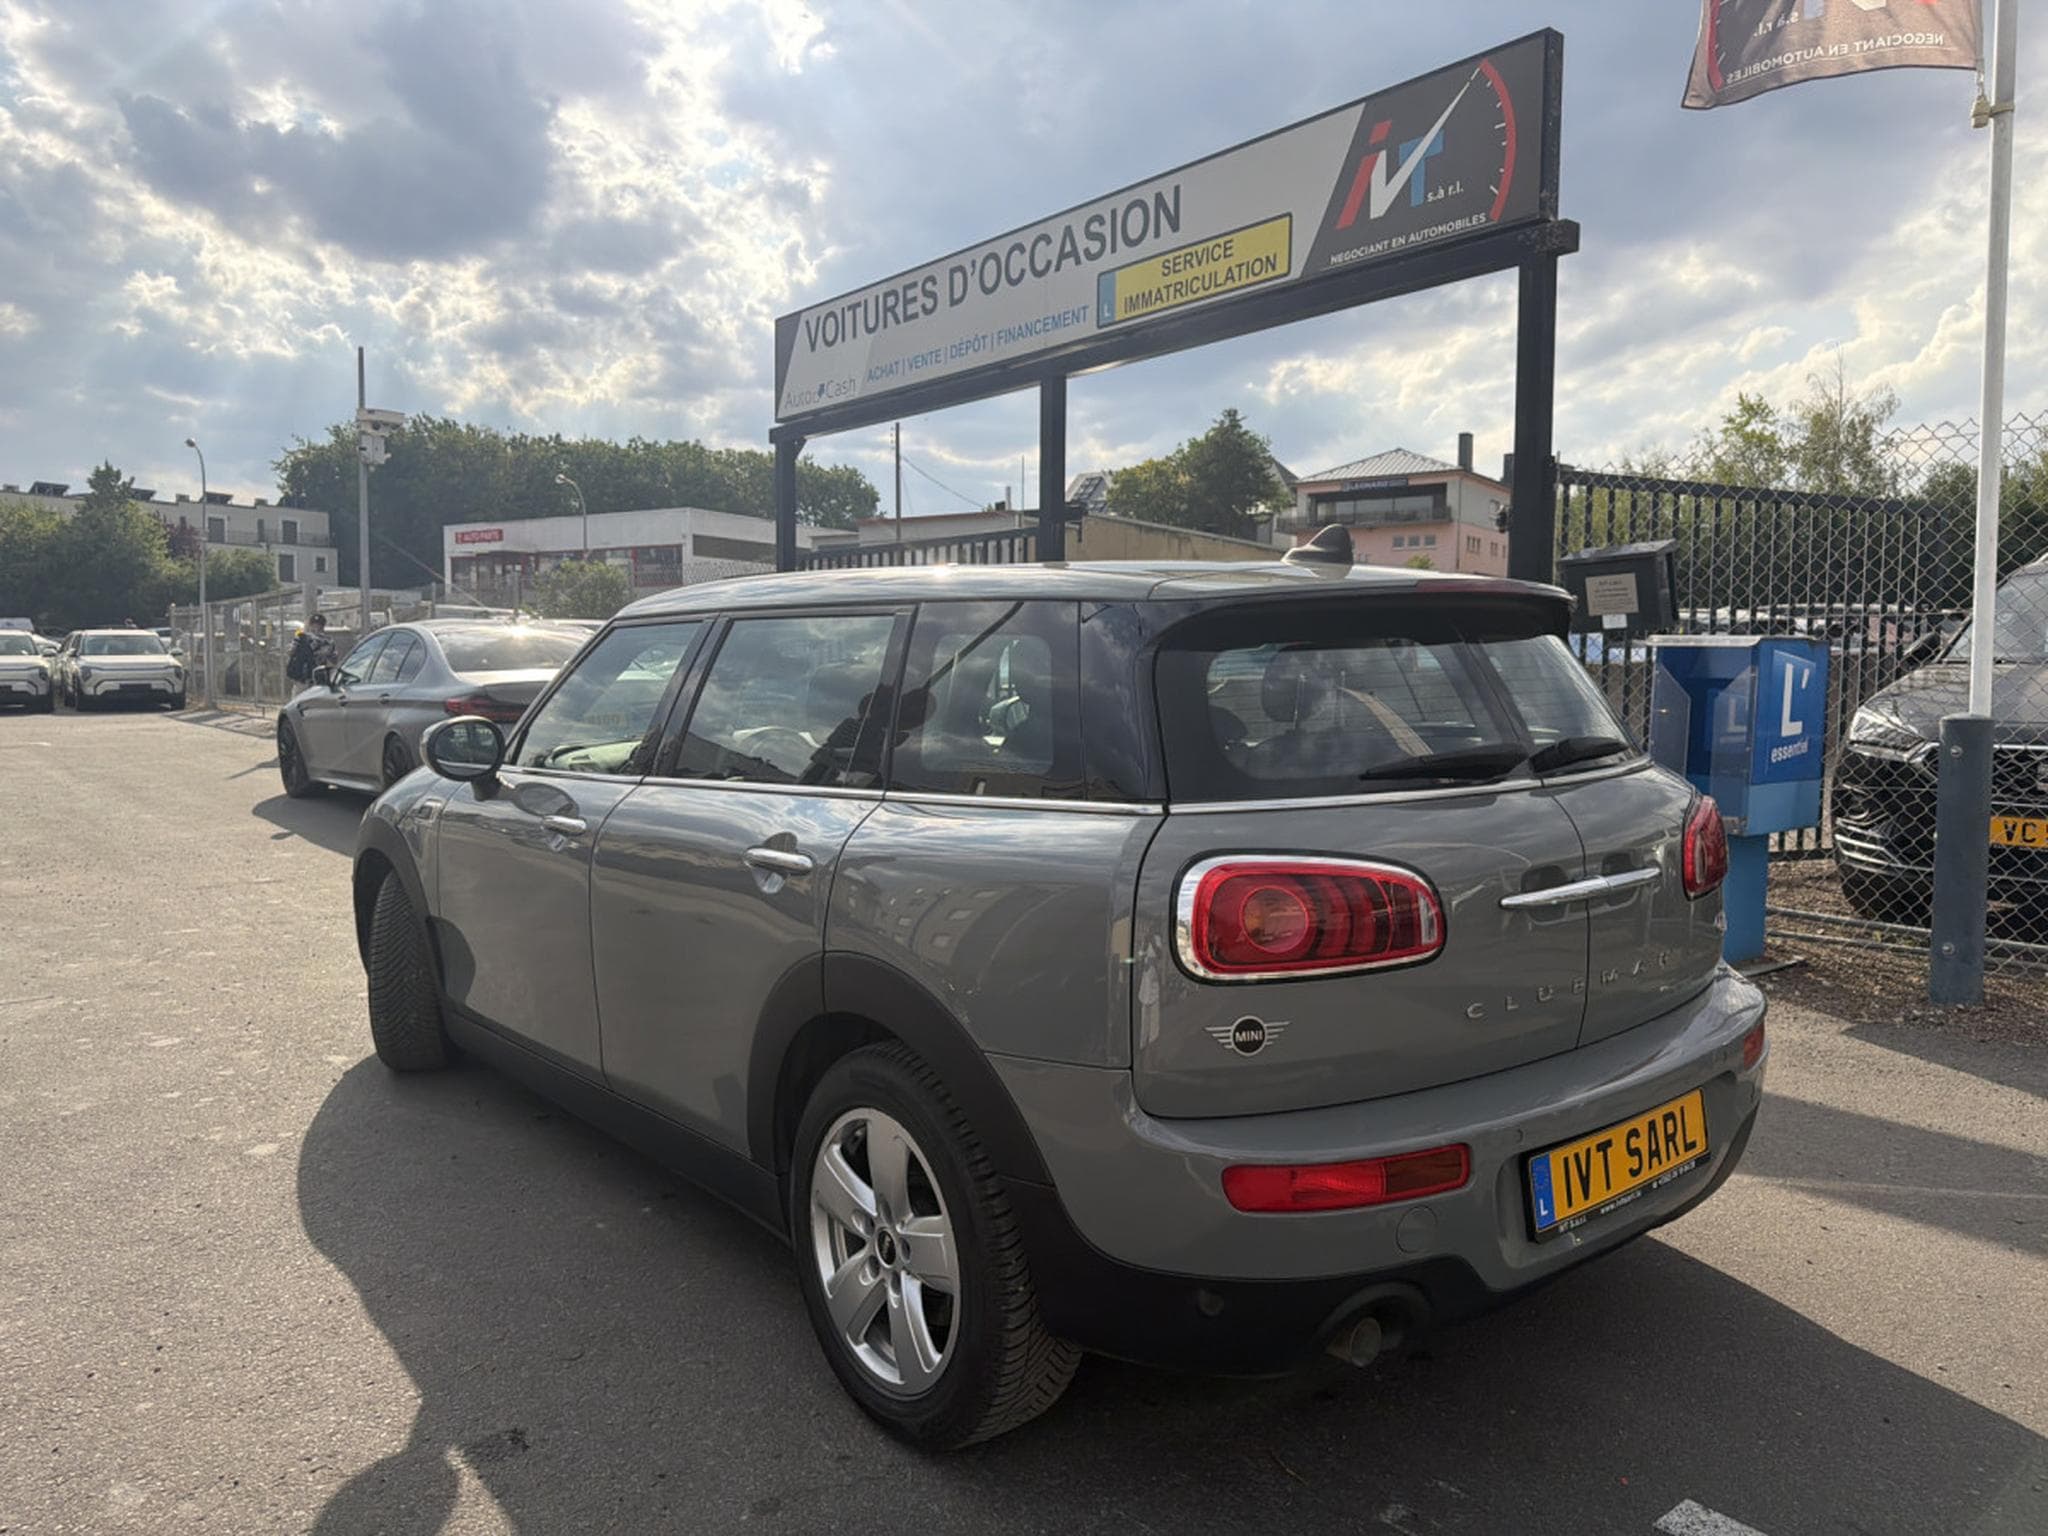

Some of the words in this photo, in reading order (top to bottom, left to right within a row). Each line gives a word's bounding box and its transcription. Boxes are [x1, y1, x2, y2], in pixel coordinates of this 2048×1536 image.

[805, 274, 938, 353] VOITURES
[948, 185, 1182, 307] D'OCCASION
[1161, 238, 1234, 277] SERVICE
[1329, 240, 1389, 265] NEGOCIANT
[1391, 234, 1406, 249] EN
[1408, 212, 1487, 243] AUTOMOBILES
[1123, 252, 1278, 315] IMMATRICULATION
[867, 361, 900, 383] ACHAT
[906, 348, 942, 371] VENTE
[950, 333, 989, 359] DÉPÔT
[997, 305, 1090, 345] FINANCEMENT
[1235, 1029, 1263, 1043] MINI
[1539, 1198, 1549, 1217] L
[1562, 1138, 1613, 1209] IVT
[1625, 1105, 1697, 1178] SARL
